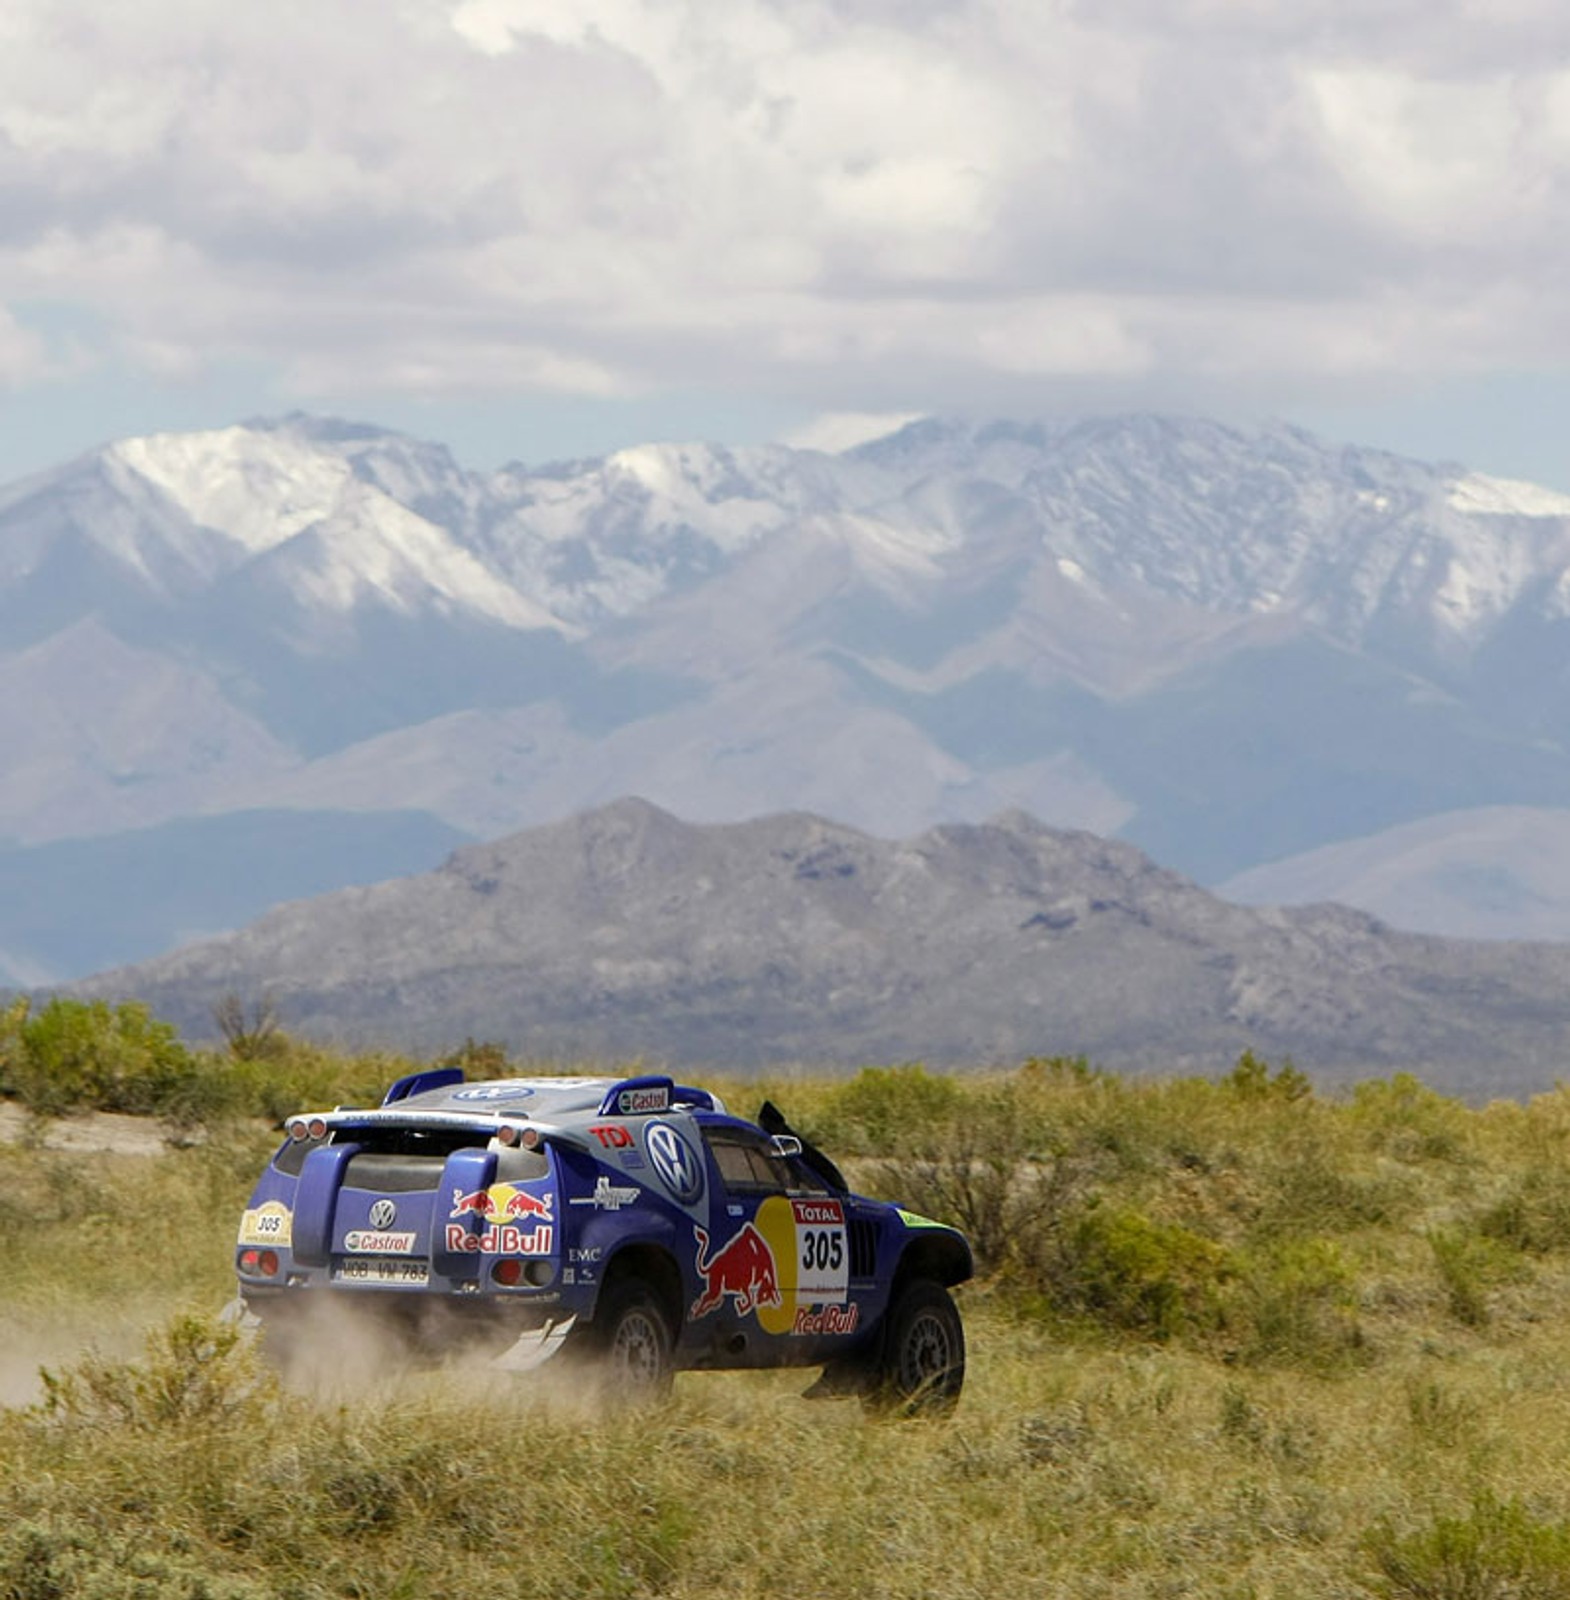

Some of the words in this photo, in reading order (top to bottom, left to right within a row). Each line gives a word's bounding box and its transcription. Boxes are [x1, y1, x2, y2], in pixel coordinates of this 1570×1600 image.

[631, 1089, 666, 1111] Castrol
[588, 1124, 635, 1149] TDI
[795, 1203, 840, 1221] TOTAL
[258, 1215, 281, 1233] 305
[360, 1233, 411, 1251] Castrol
[445, 1224, 499, 1253] Red
[501, 1225, 552, 1255] Bull
[802, 1230, 843, 1271] 305
[793, 1304, 828, 1335] Red
[824, 1302, 858, 1334] Bull
